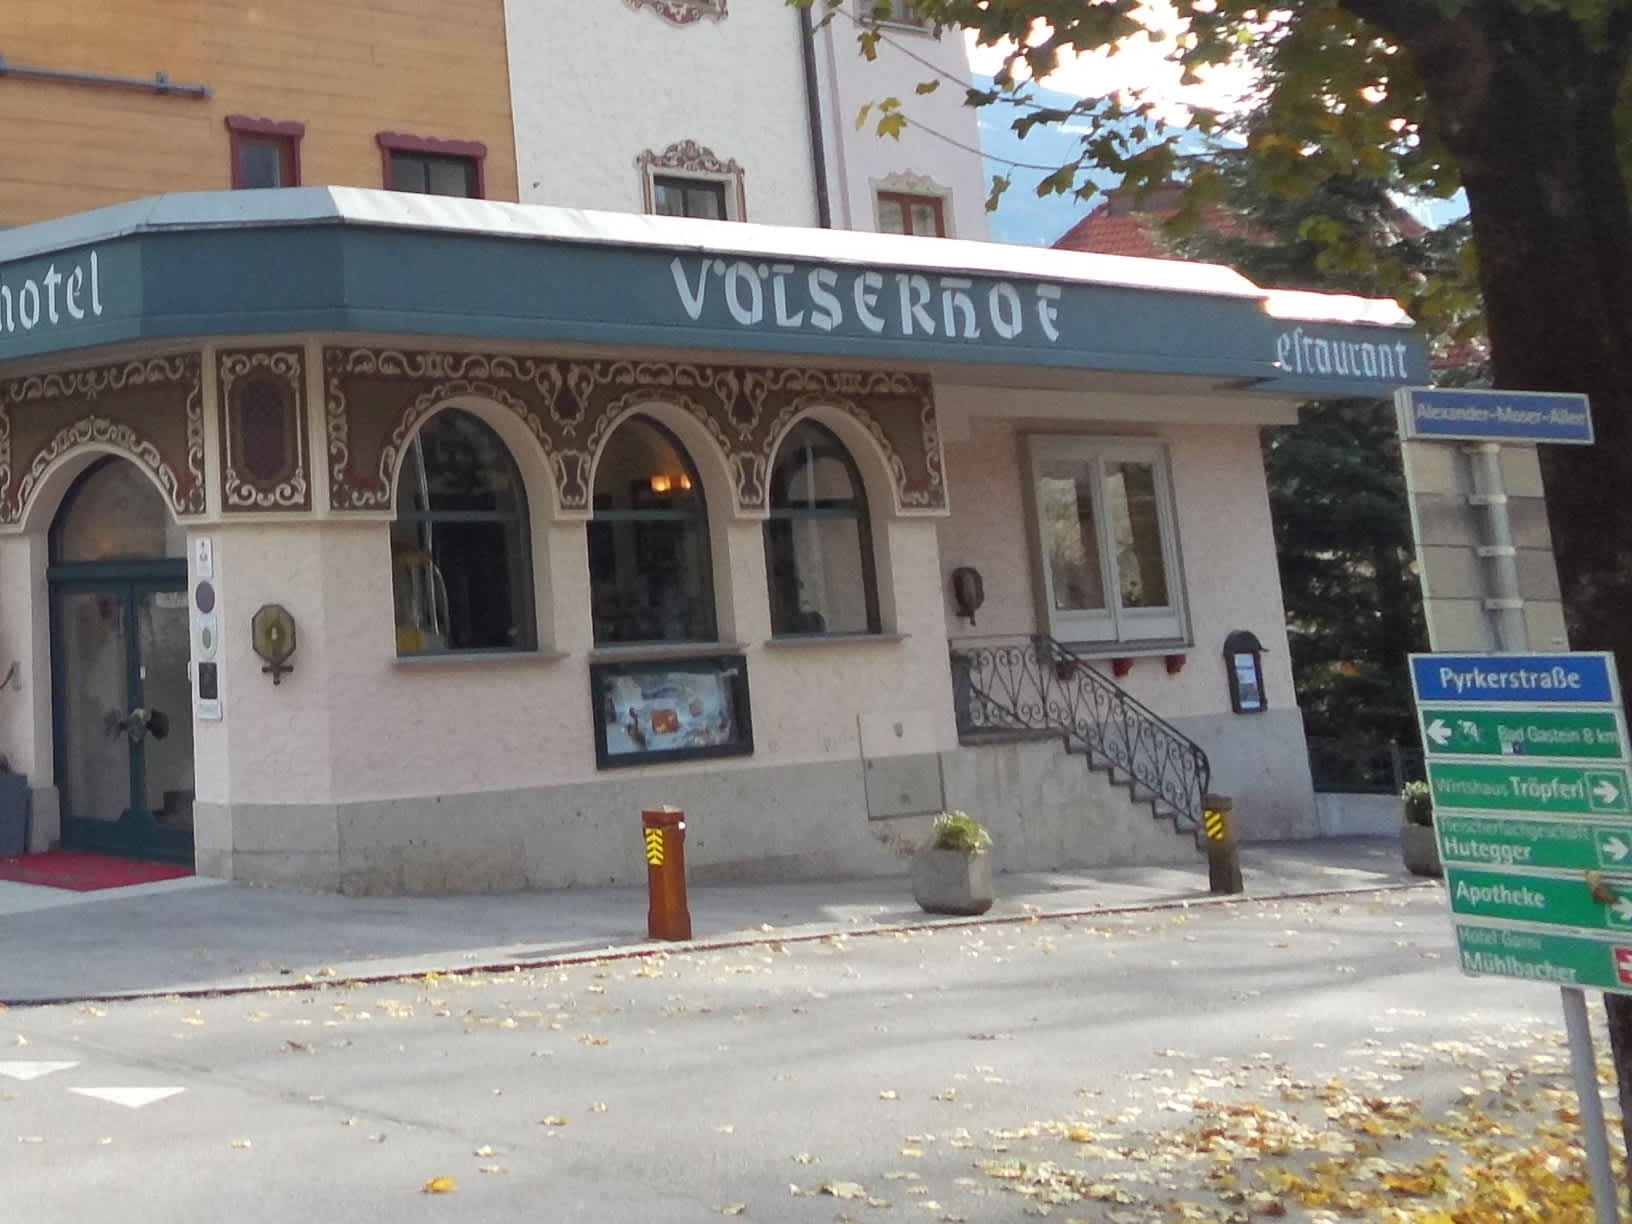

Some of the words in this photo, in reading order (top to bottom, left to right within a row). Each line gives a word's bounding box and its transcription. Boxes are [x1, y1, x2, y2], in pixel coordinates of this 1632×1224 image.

[1439, 666, 1581, 694] Pyrkerstraße
[1498, 724, 1524, 743] Bad
[1527, 725, 1581, 743] Gastein
[1509, 776, 1584, 802] Tröpferl
[1444, 835, 1532, 863] Hutegger
[1456, 880, 1545, 908] Apotheke
[1458, 926, 1498, 945] Hotel
[1462, 951, 1577, 982] Mühlbacher
